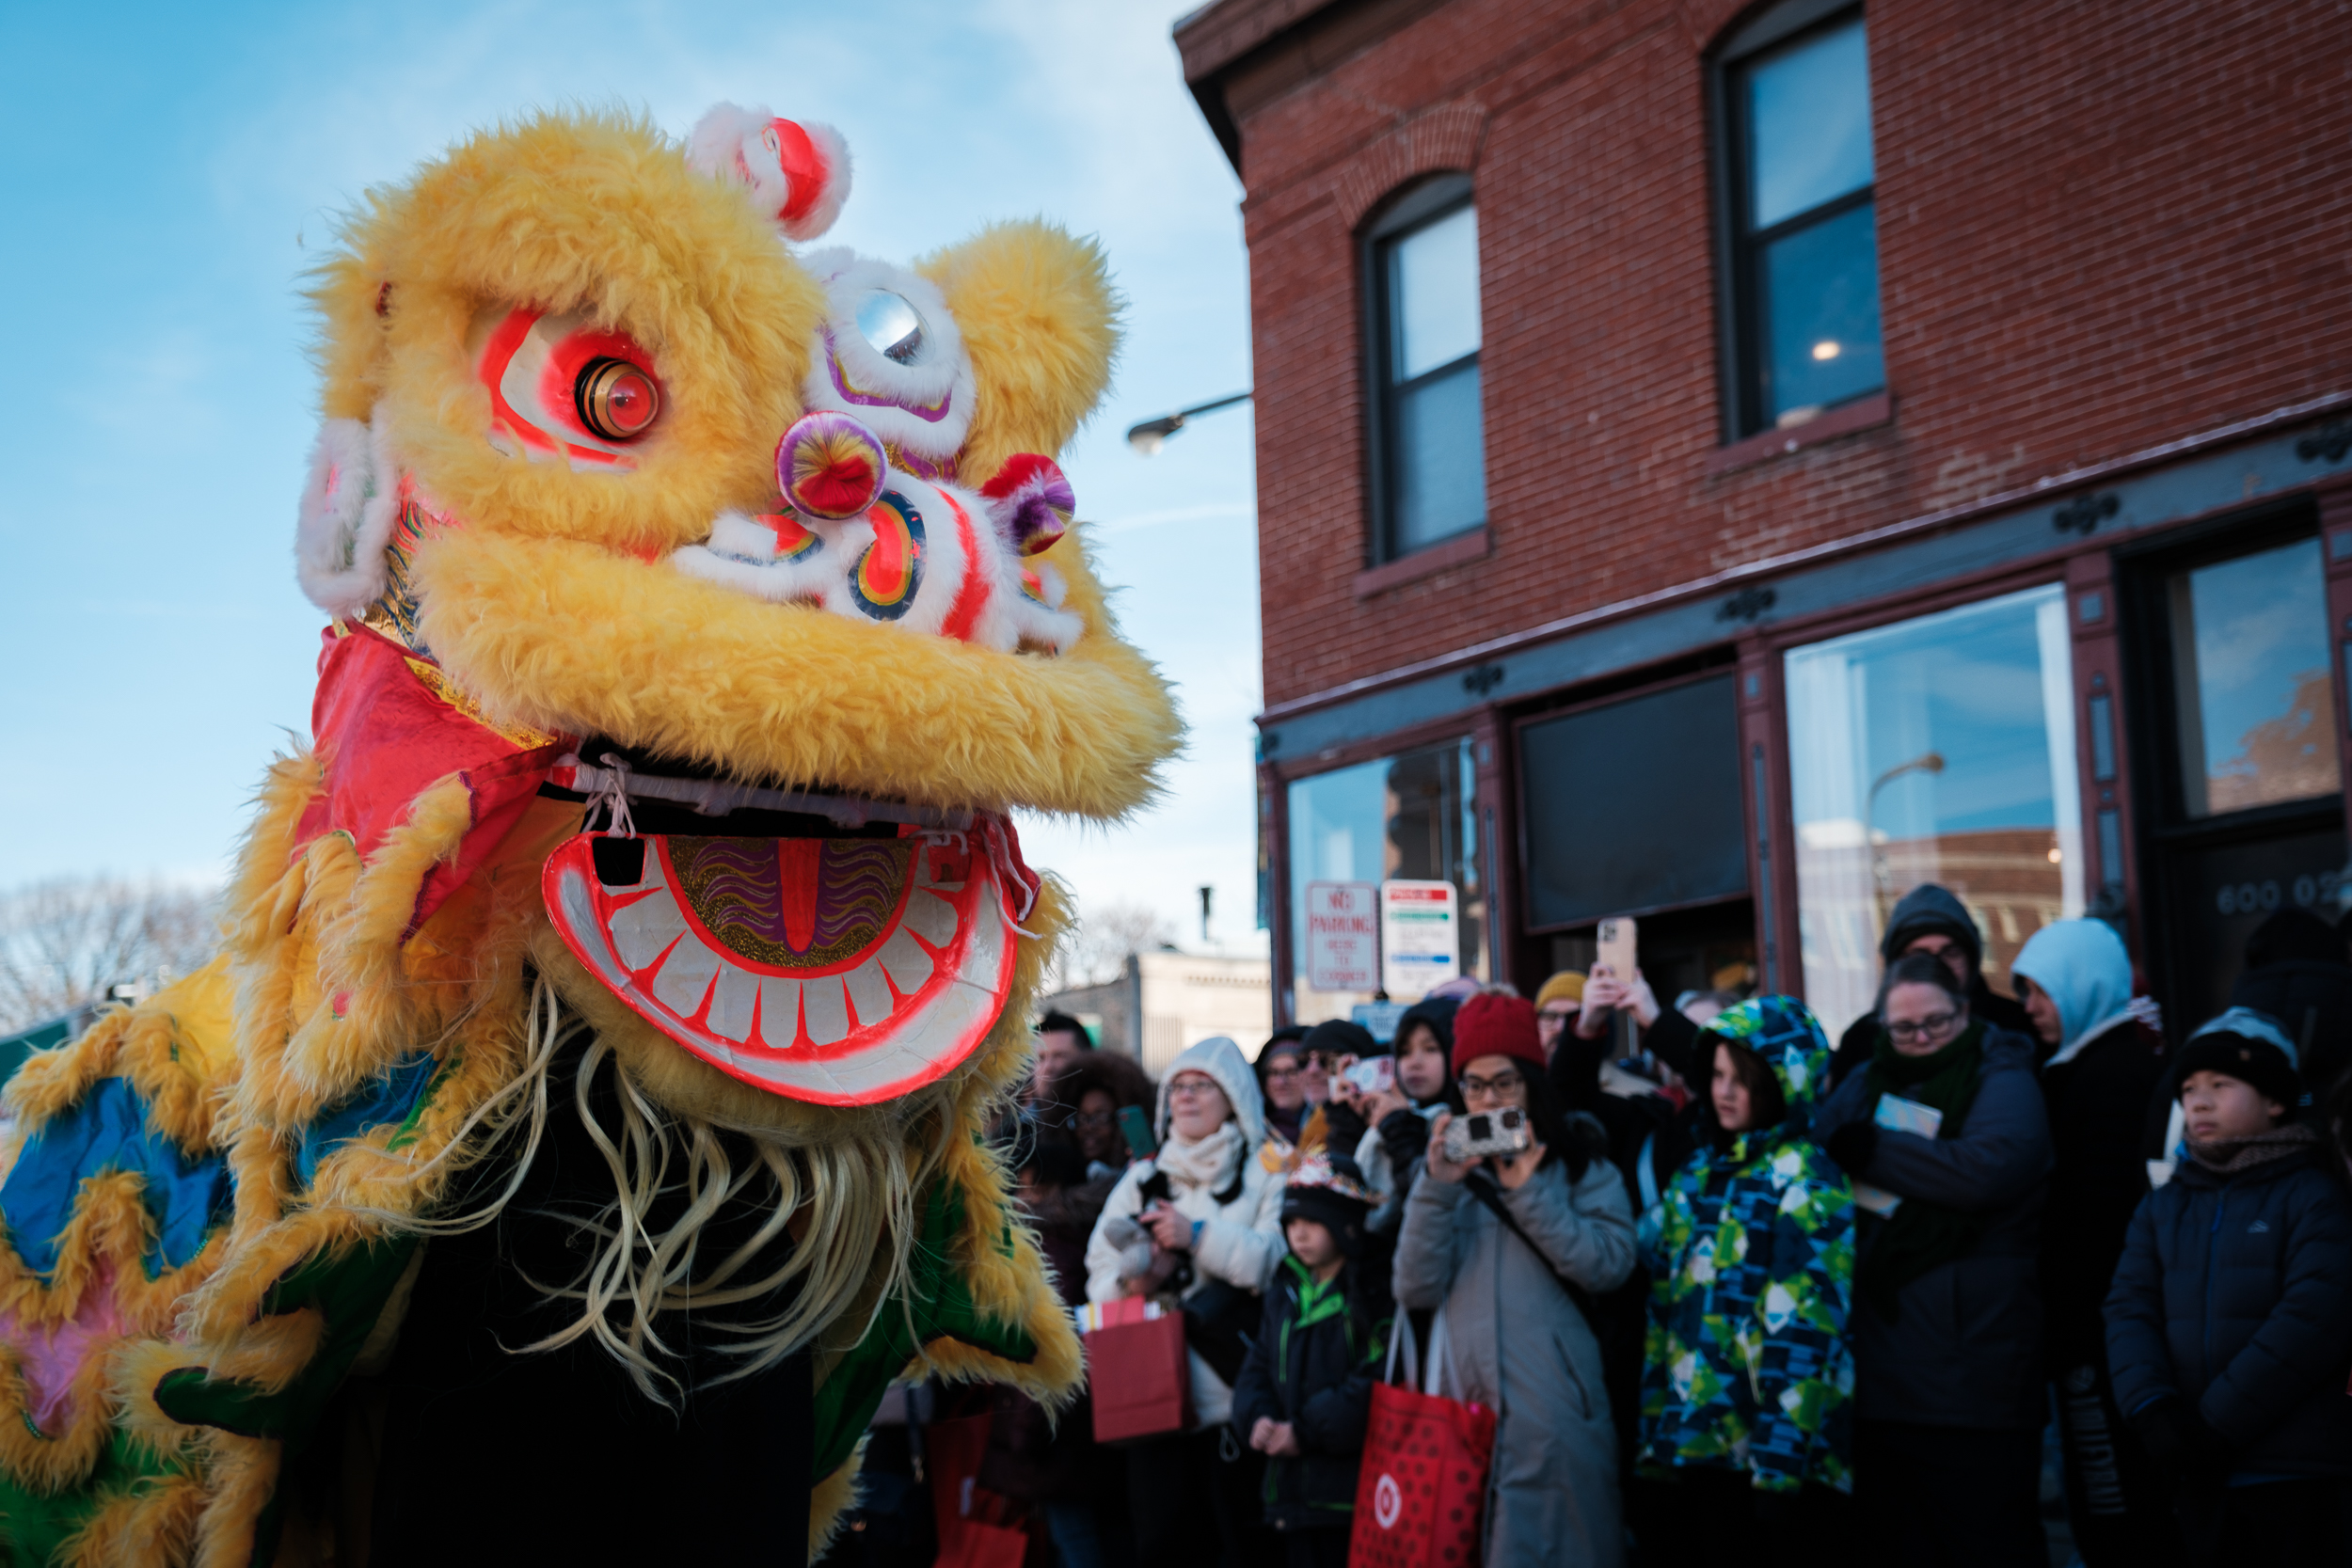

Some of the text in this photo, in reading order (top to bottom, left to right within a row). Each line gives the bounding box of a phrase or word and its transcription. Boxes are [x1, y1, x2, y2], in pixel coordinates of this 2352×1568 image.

[1328, 892, 1354, 911] NO
[2217, 879, 2280, 915] 600
[1309, 914, 1375, 934] PARKING
